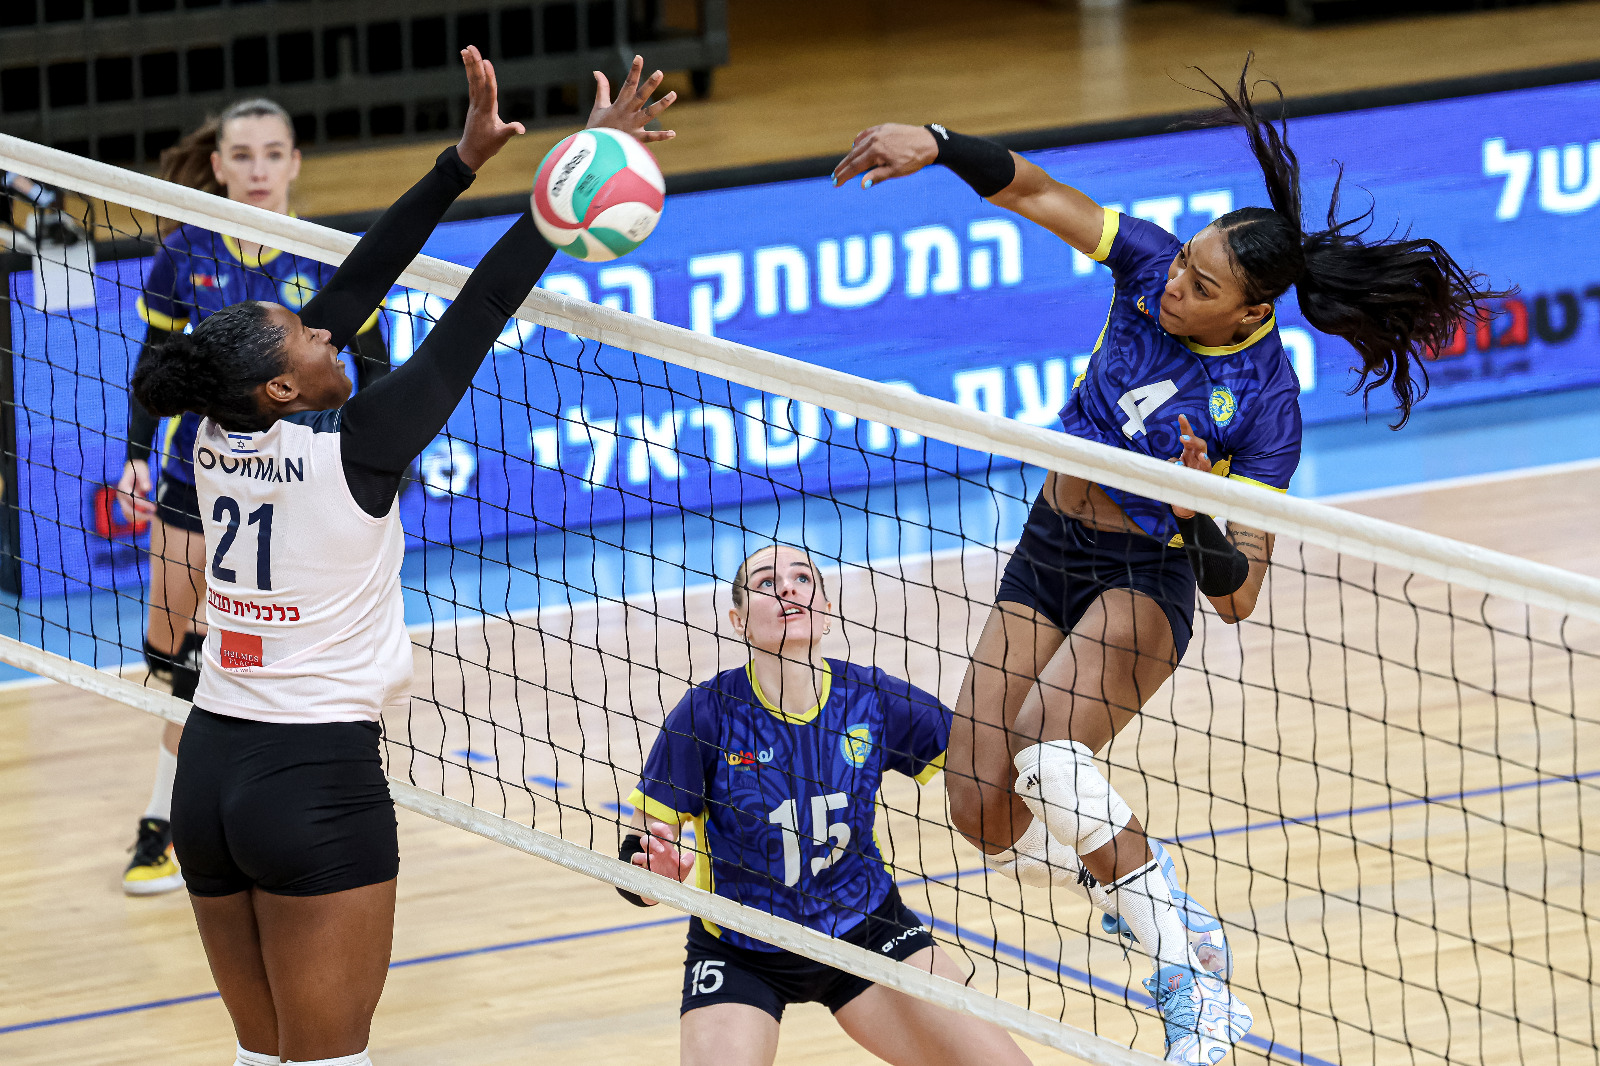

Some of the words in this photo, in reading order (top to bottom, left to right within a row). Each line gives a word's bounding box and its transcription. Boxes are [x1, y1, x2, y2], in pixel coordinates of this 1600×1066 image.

[688, 218, 1023, 337] המשחק
[1117, 378, 1179, 440] 4
[211, 495, 274, 591] 21
[233, 600, 300, 622] כלכלית
[223, 649, 259, 663] HOLMES
[768, 791, 851, 888] 15
[691, 960, 726, 996] 15
